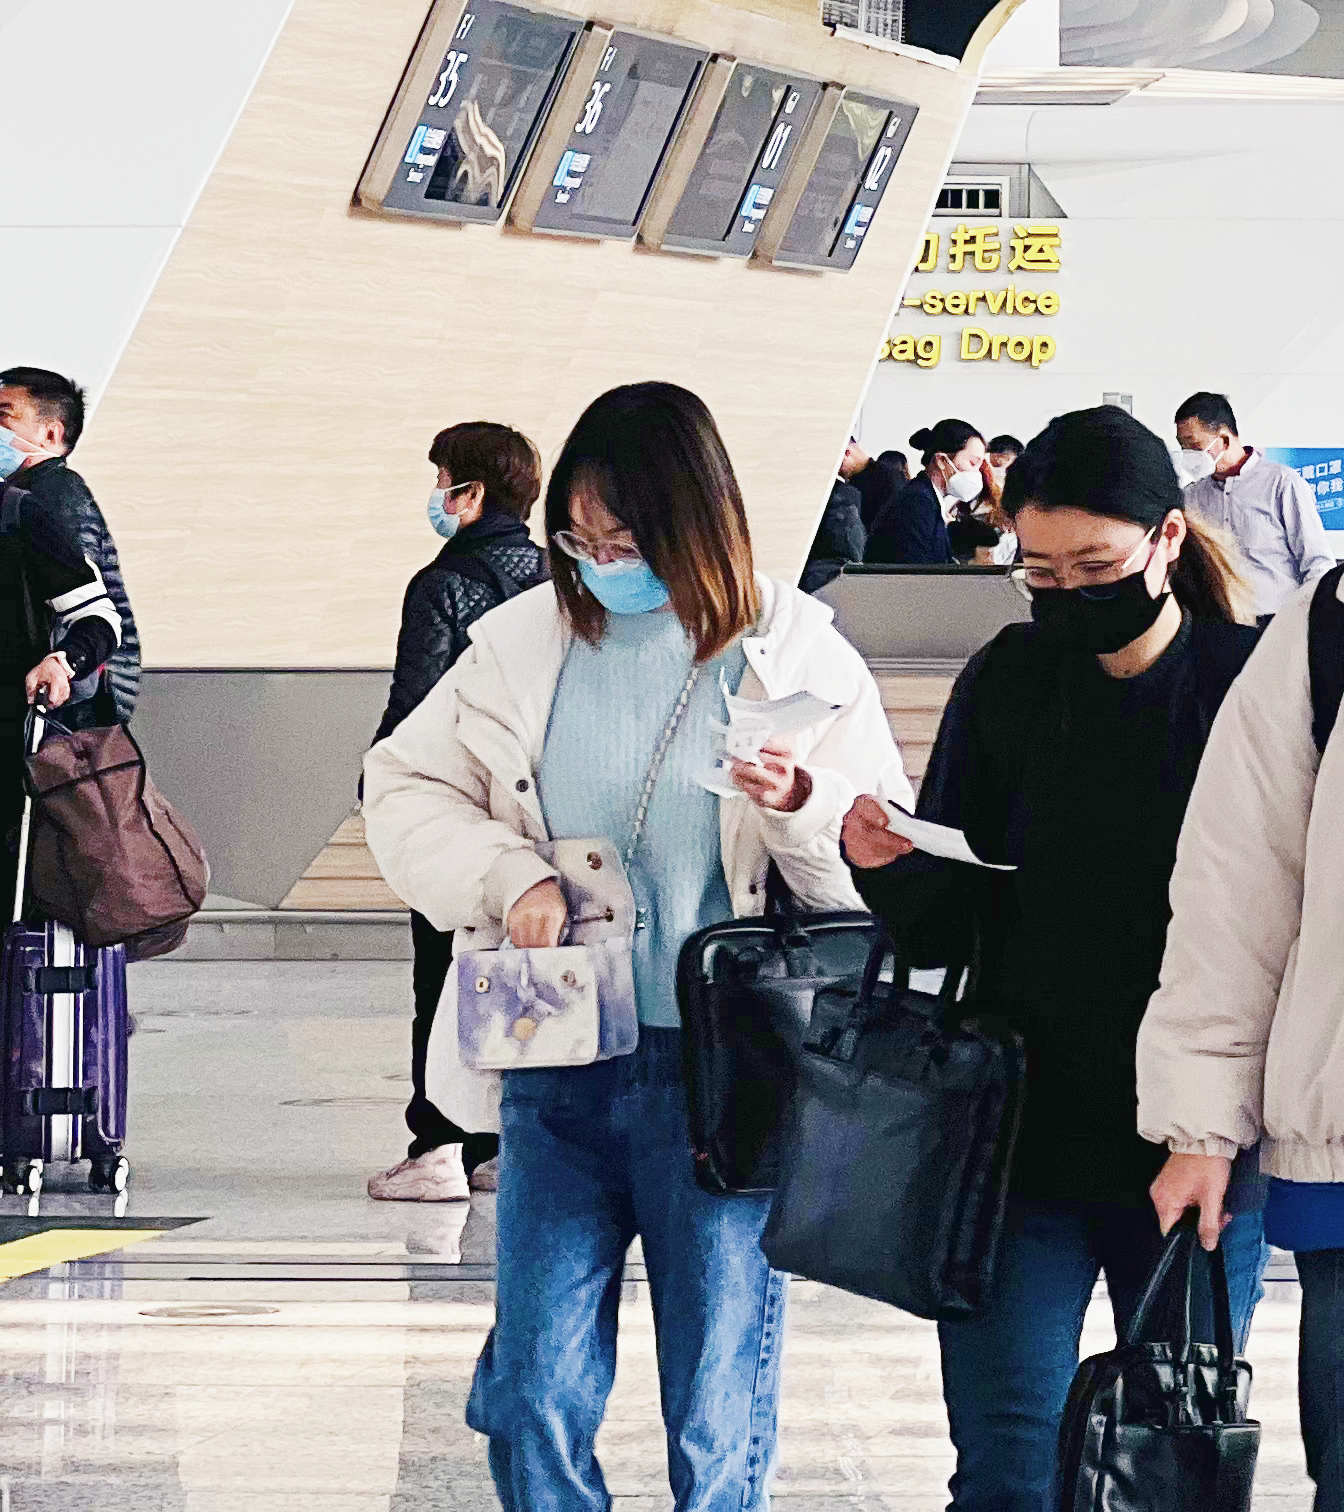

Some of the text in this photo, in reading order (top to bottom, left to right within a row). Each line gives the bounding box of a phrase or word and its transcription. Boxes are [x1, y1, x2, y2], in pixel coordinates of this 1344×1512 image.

[428, 50, 469, 108] 35
[574, 81, 612, 135] 36
[761, 121, 793, 170] 01
[864, 145, 892, 192] 02
[959, 327, 1057, 369] Drop
